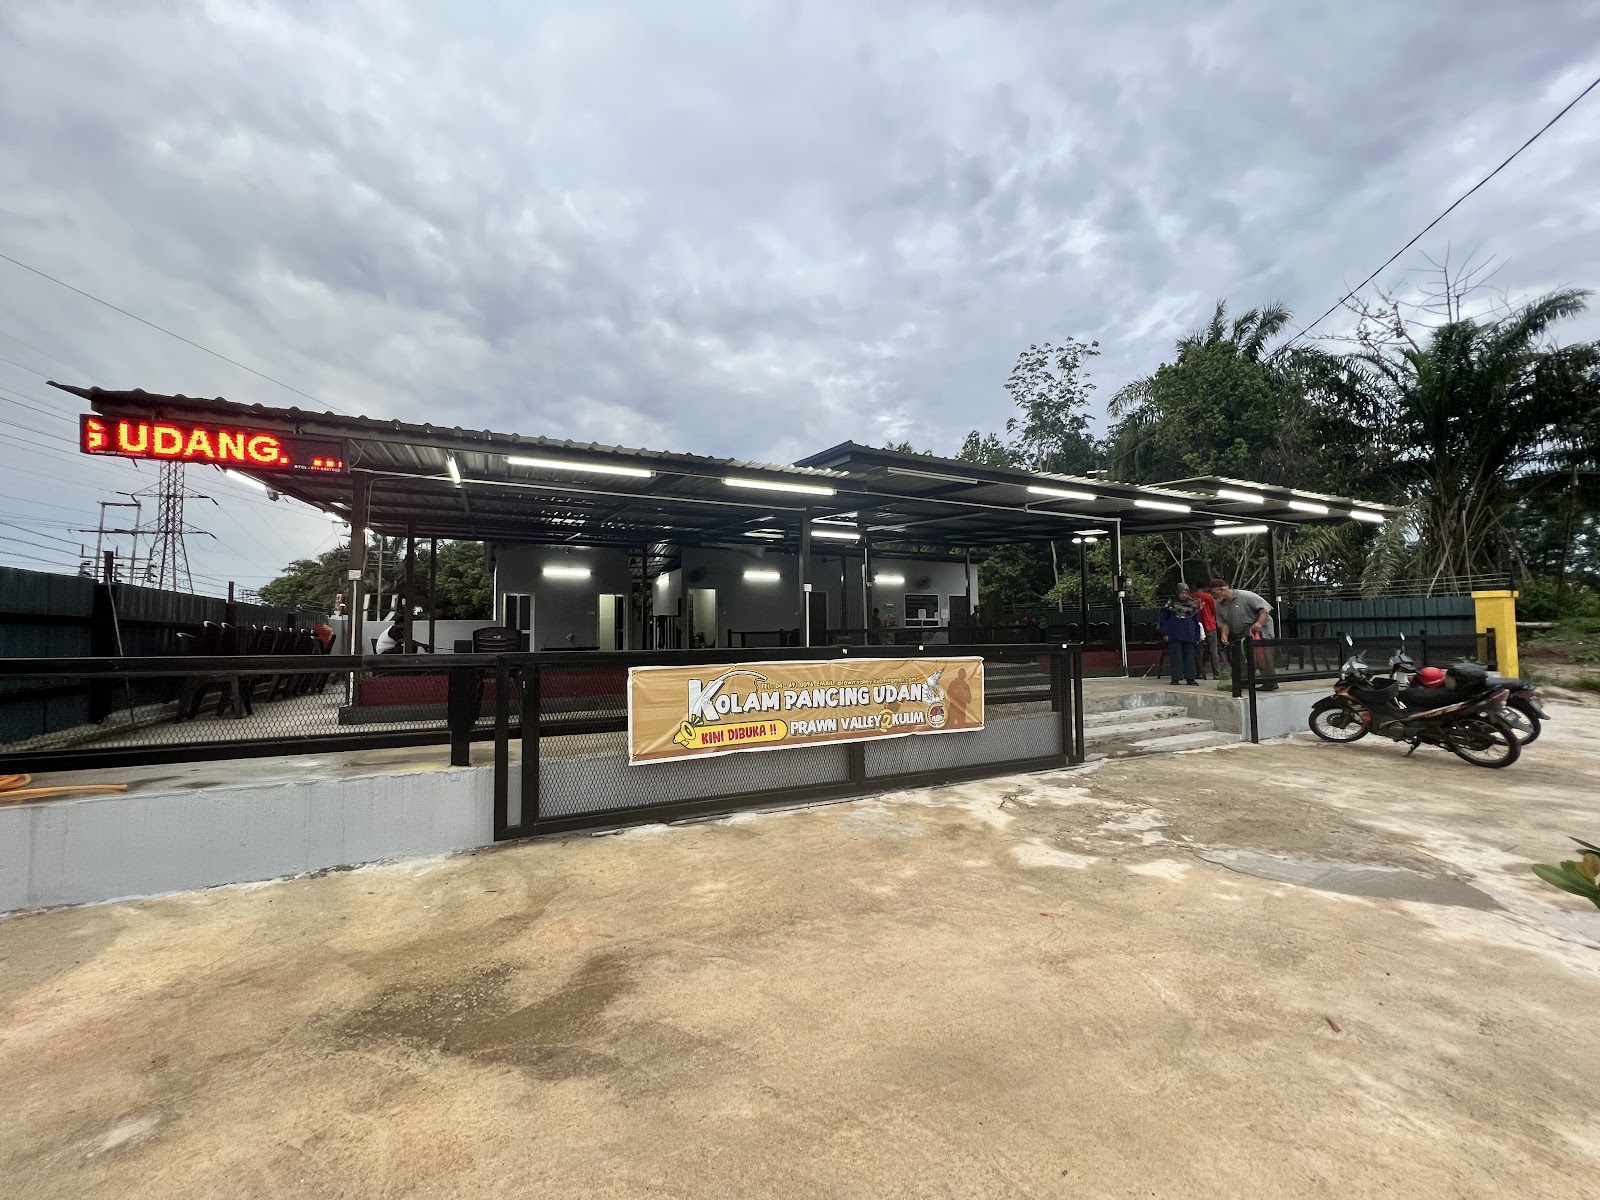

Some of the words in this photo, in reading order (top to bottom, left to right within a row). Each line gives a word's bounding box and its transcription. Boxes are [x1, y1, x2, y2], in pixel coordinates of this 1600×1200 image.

[783, 686, 870, 710] PANCING
[701, 729, 725, 745] KINI
[727, 724, 767, 742] DIBUKA
[790, 718, 838, 736] PRAWN
